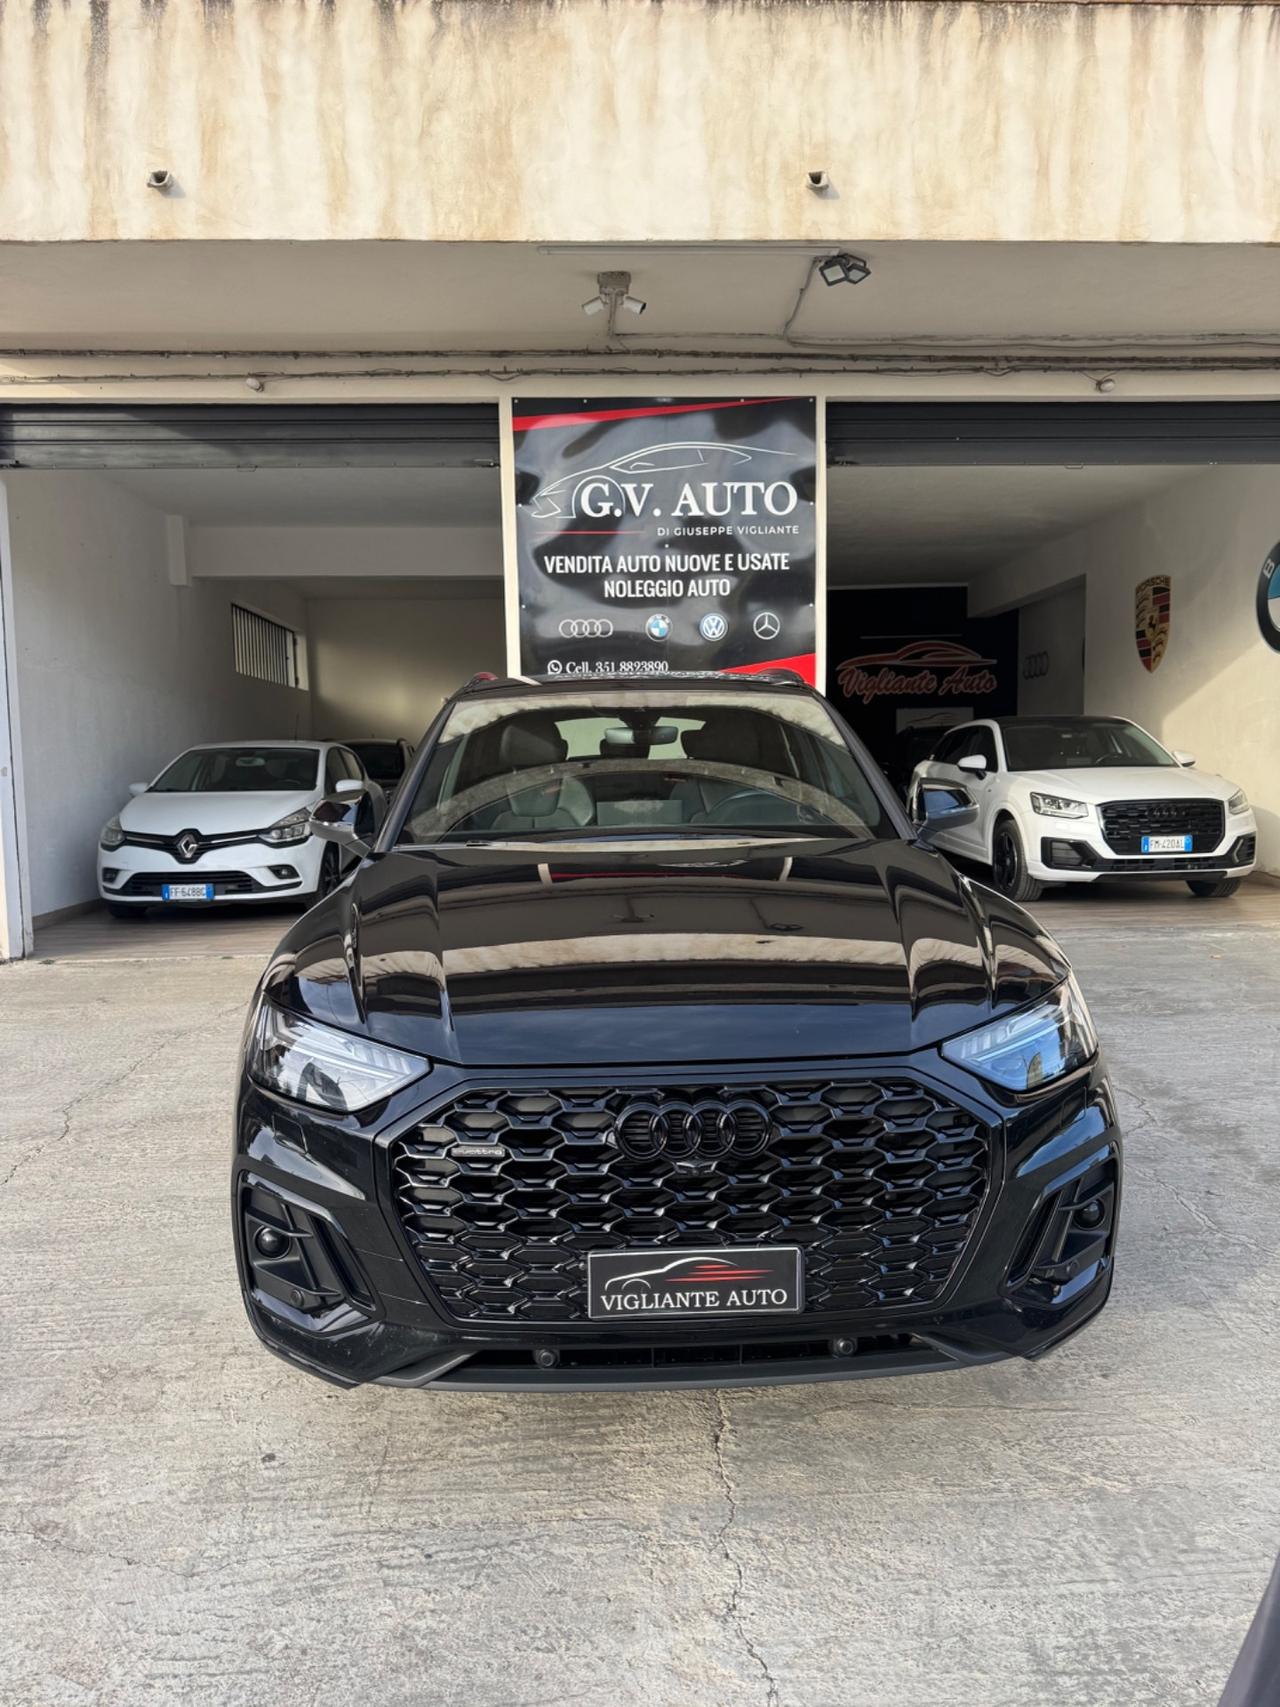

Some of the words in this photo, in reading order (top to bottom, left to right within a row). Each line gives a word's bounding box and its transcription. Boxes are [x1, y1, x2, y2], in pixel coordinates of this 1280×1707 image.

[580, 482, 662, 518] G.V.
[671, 481, 798, 517] AUTO
[657, 527, 670, 537] DI
[673, 526, 733, 536] GIUSEPPE
[737, 525, 800, 535] VIGLIANTE
[543, 555, 613, 574] VENDITA
[616, 554, 661, 573] AUTO
[665, 553, 721, 573] NUOVE
[724, 553, 735, 572] E
[737, 552, 791, 571] USATE
[603, 579, 684, 598] NOLEGGIO
[687, 578, 731, 597] AUTO
[595, 661, 616, 672] 351
[838, 667, 938, 704] Vigliante
[938, 665, 997, 695] Auto
[601, 1290, 720, 1310] VIGLIANTE
[726, 1288, 788, 1306] AUTO
